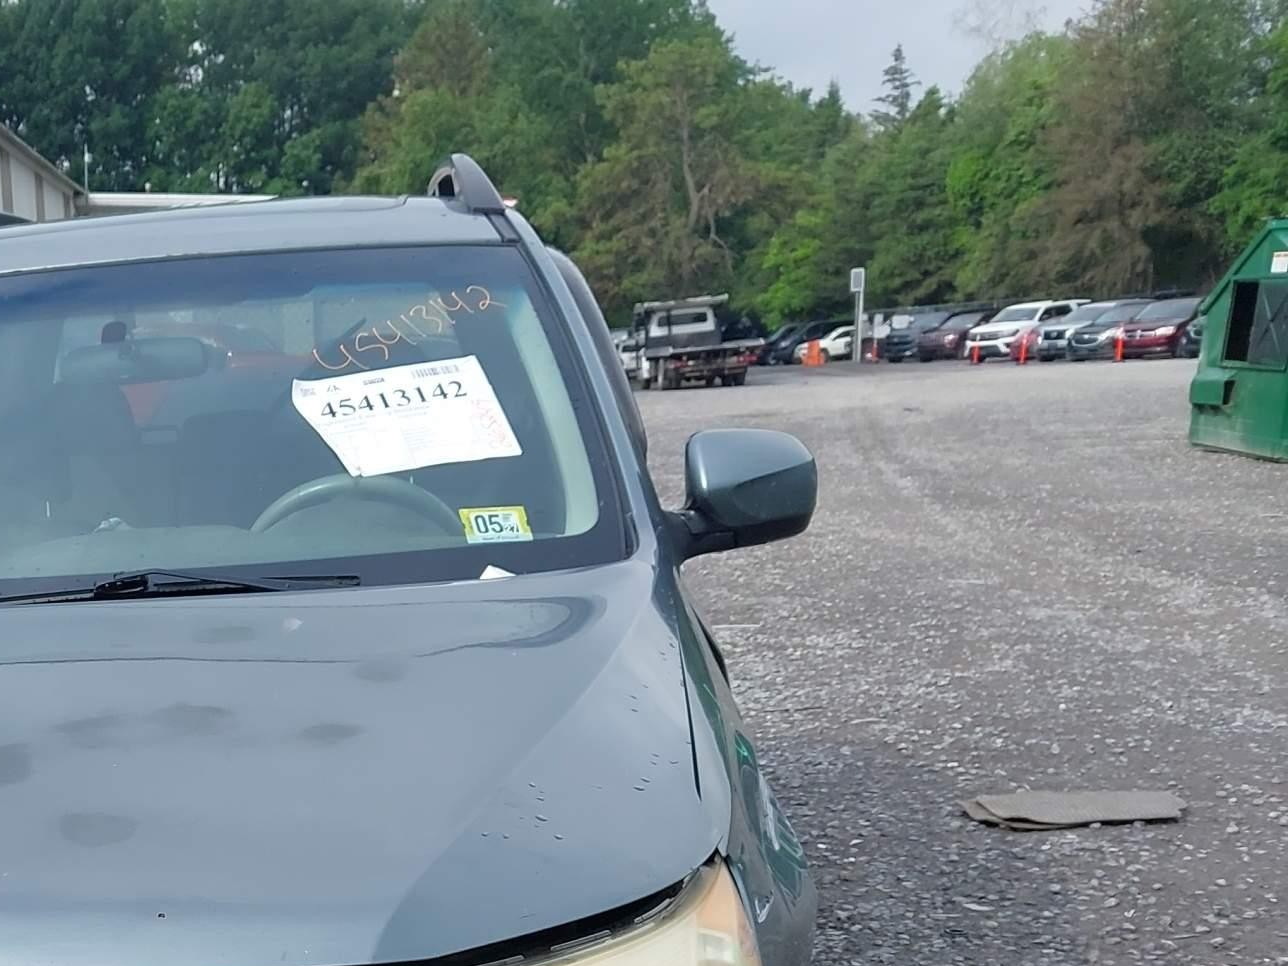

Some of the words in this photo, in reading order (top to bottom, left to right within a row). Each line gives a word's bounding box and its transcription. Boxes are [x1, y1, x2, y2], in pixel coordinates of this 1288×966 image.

[312, 285, 508, 370] 45413142
[320, 380, 469, 420] 45413142
[474, 514, 504, 534] 05
